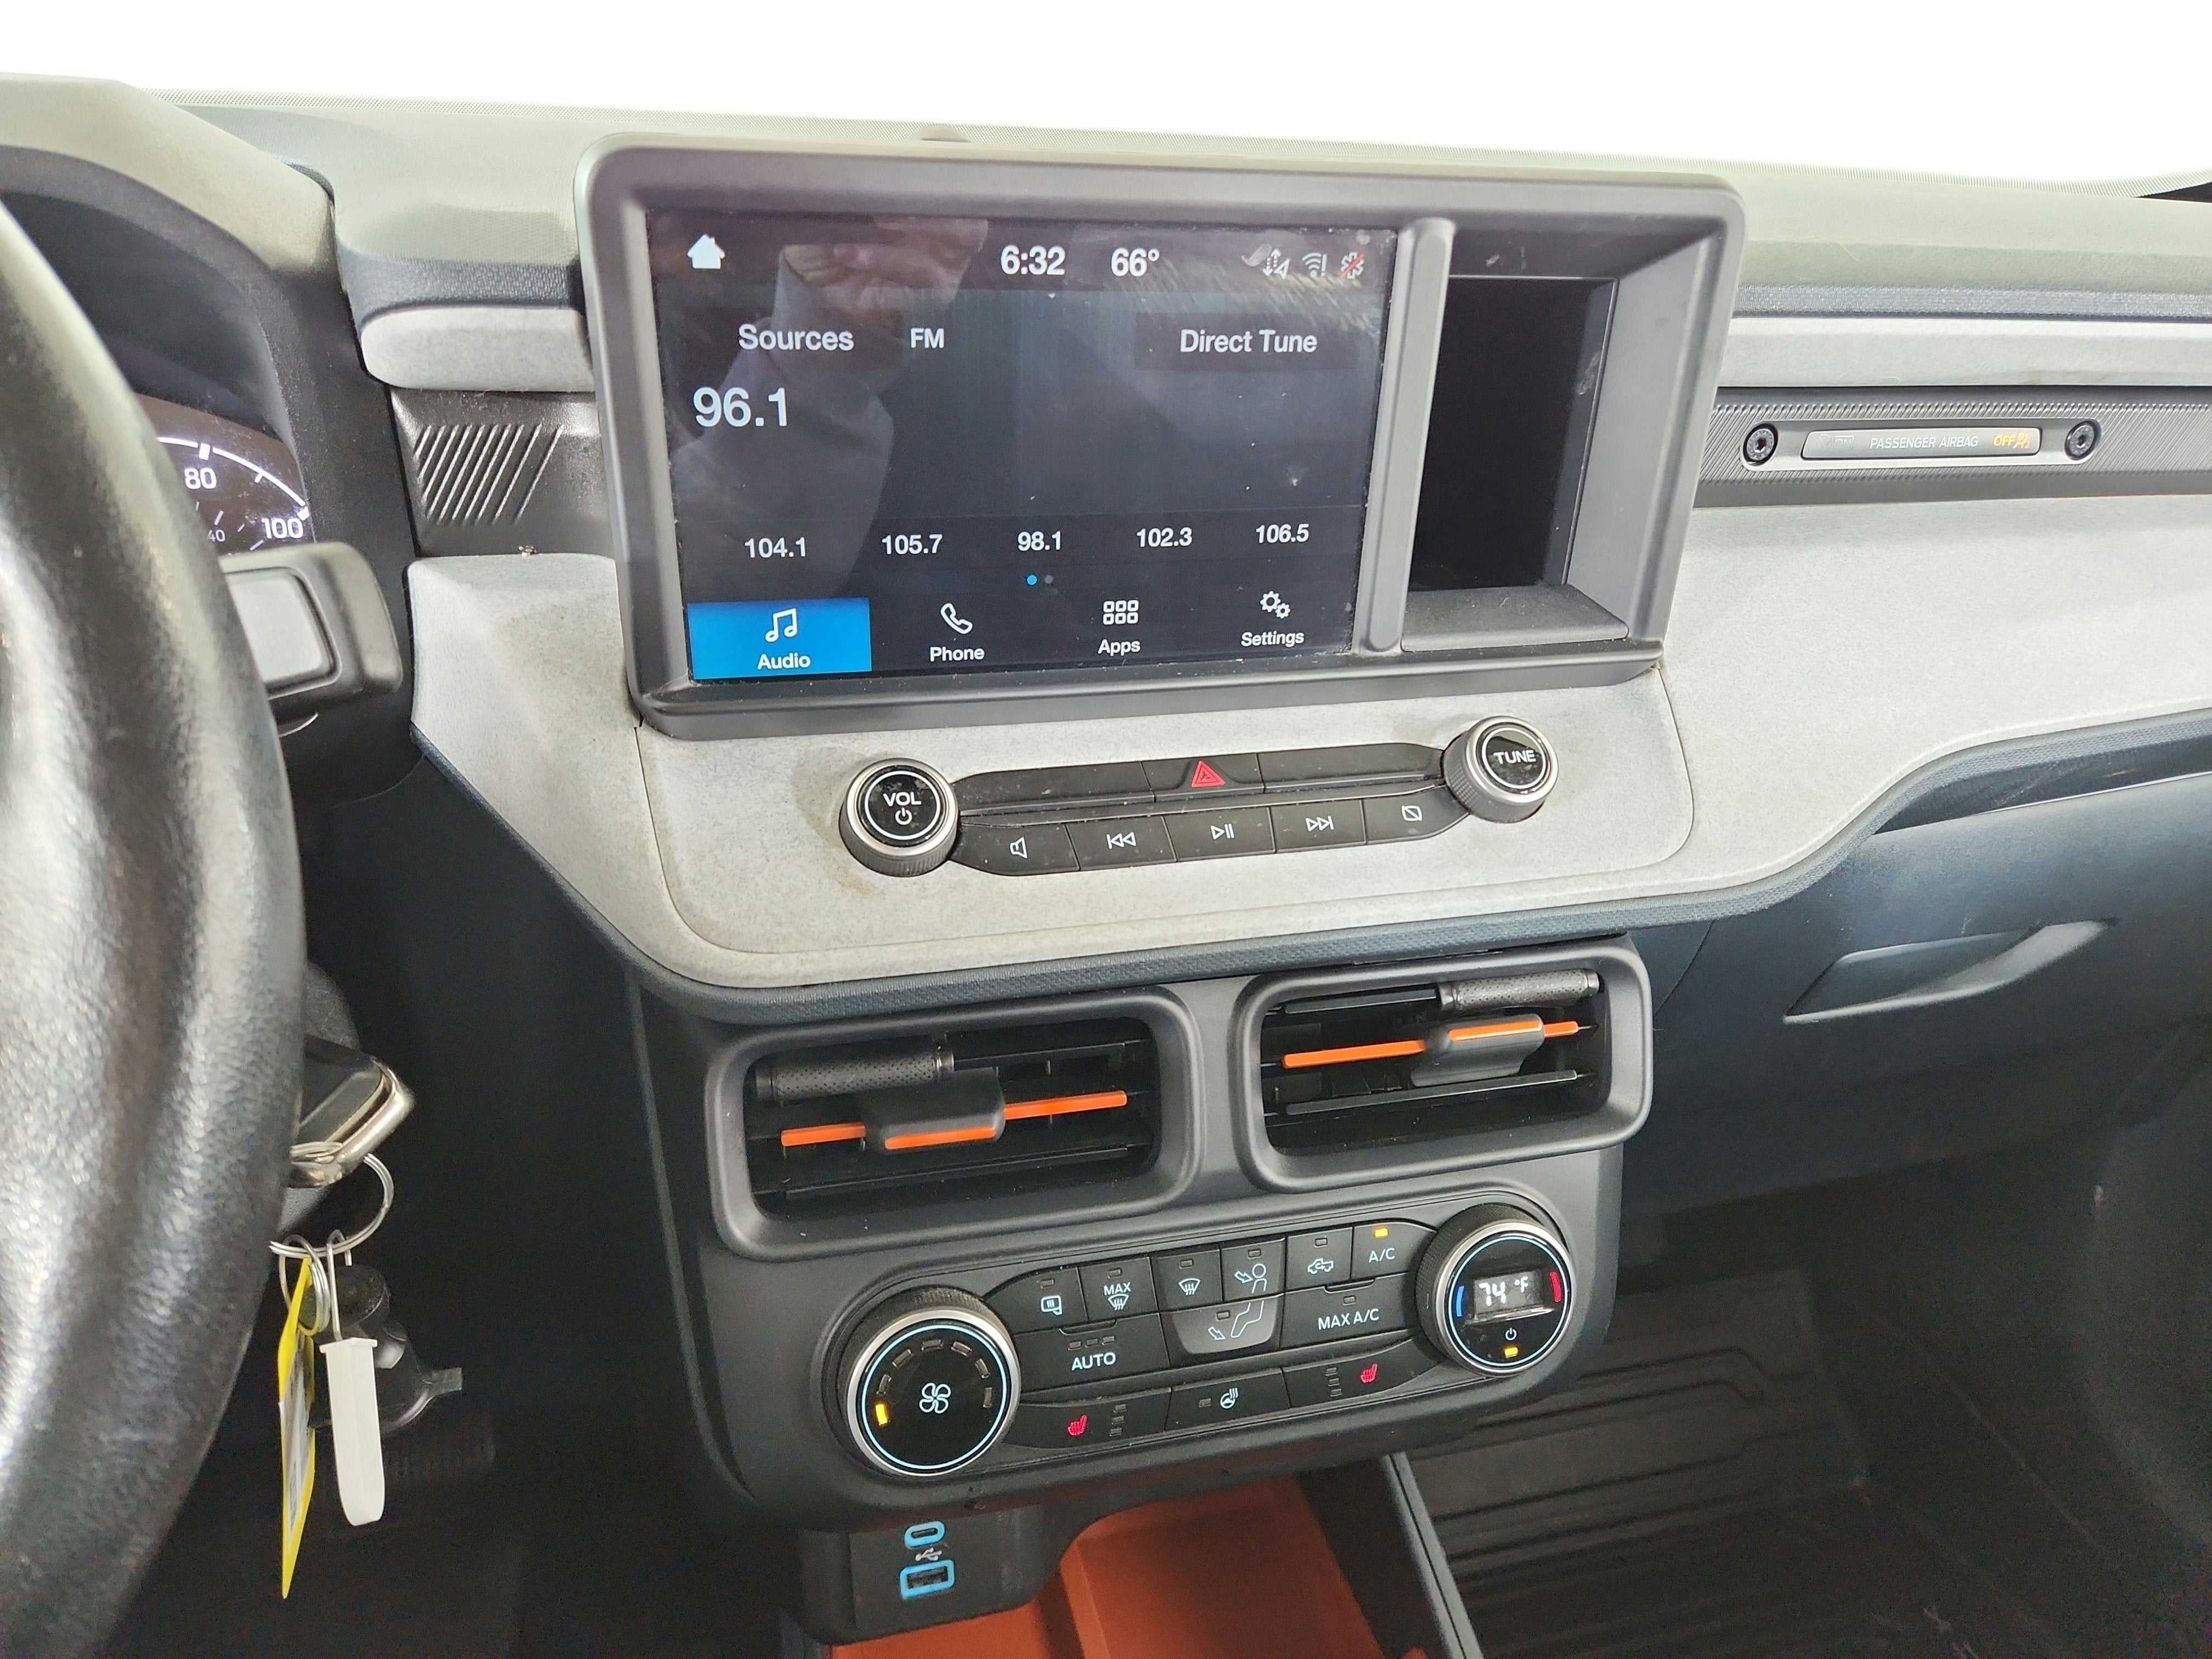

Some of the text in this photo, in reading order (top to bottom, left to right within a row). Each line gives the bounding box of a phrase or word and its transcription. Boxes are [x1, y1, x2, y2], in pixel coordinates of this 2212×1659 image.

[1001, 245, 1065, 275] 6:32
[1111, 247, 1160, 277] 66°
[738, 324, 854, 351] Sources
[910, 328, 944, 348] FM
[1180, 329, 1318, 353] Direct Tune
[693, 387, 787, 427] 96.1
[1869, 436, 1978, 449] PASSENGER AIRBAG
[1993, 435, 2016, 446] OFF
[184, 467, 217, 489] 80
[207, 529, 225, 542] 40
[261, 518, 304, 539] 100
[1136, 527, 1192, 548] 102.3
[1256, 523, 1309, 544] 106.5
[744, 537, 806, 558] 104.1
[882, 534, 943, 555] 105.7
[1018, 531, 1060, 551] 98.1
[1098, 639, 1141, 657] Apps
[1241, 630, 1305, 647] Settings
[757, 652, 811, 670] Audio
[930, 646, 985, 662] Phone
[1493, 749, 1536, 765] TUNE
[883, 792, 922, 806] VOL
[1368, 1248, 1396, 1263] A/C
[1104, 1282, 1131, 1295] MAX
[1479, 1282, 1506, 1307] 74
[1318, 1308, 1380, 1330] MAX A/C
[1071, 1352, 1116, 1371] AUTO
